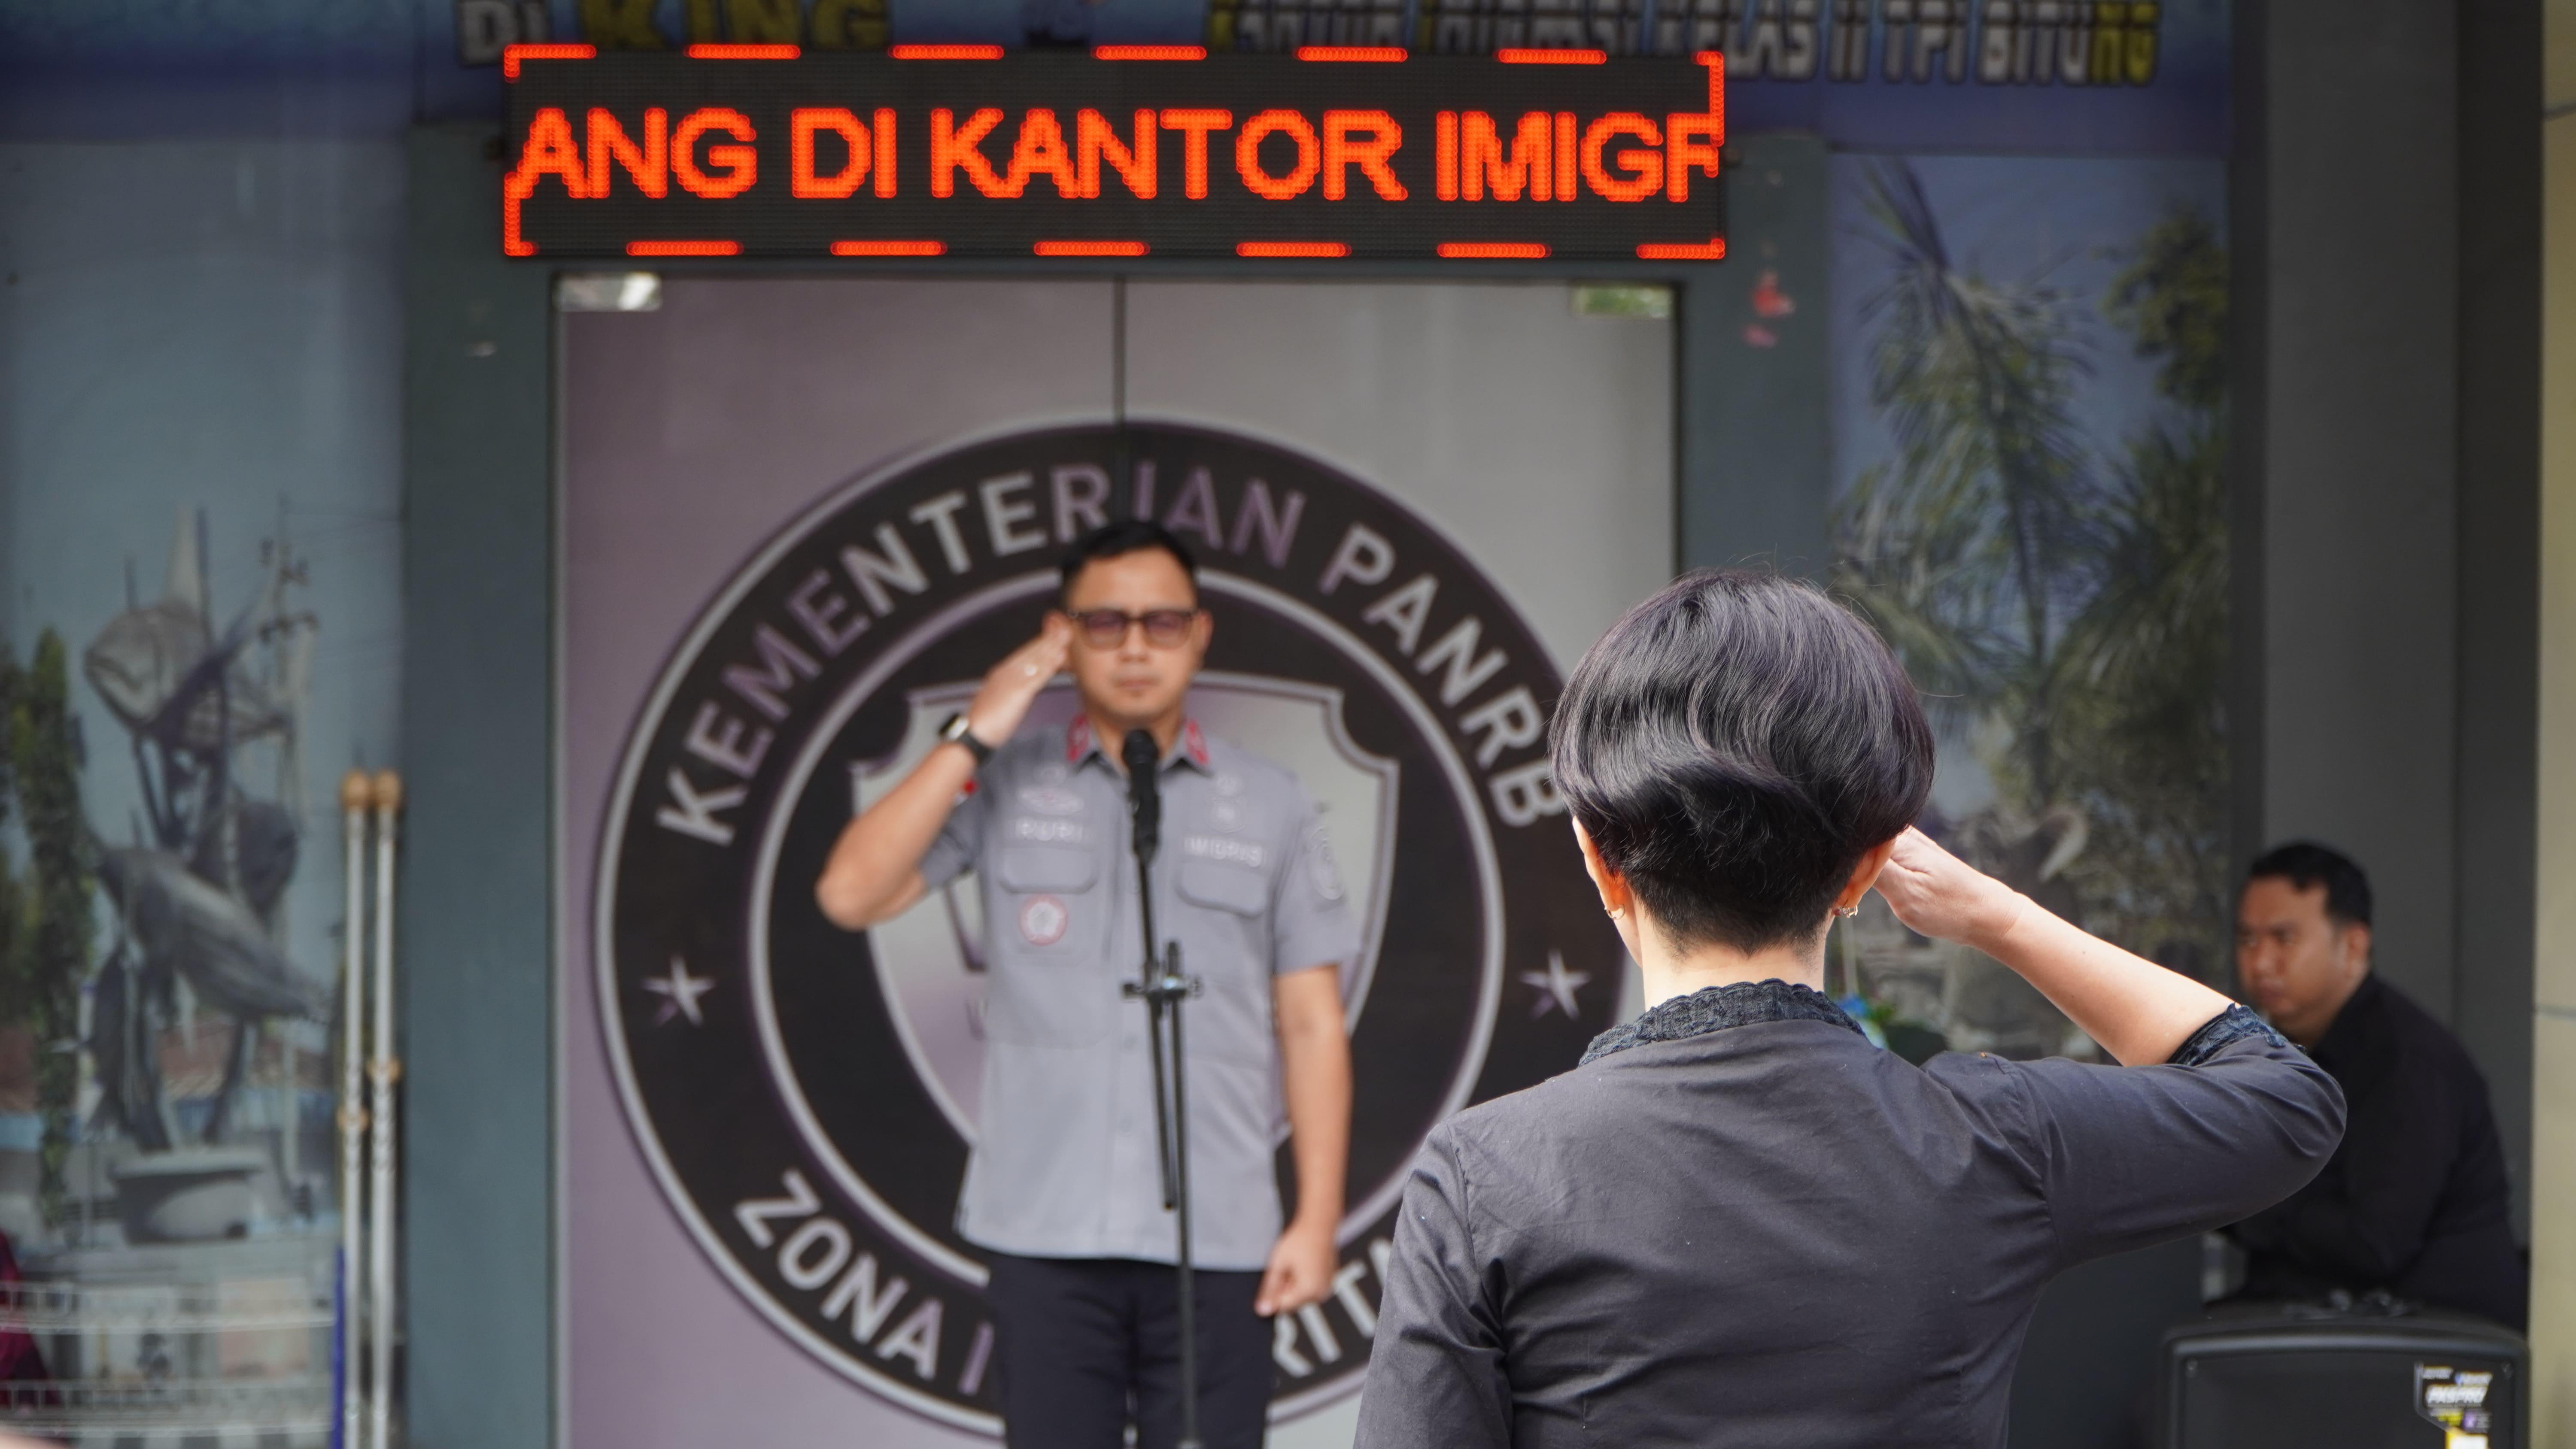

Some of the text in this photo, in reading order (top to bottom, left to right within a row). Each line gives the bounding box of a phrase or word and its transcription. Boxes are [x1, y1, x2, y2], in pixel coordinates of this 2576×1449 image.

[516, 107, 757, 199] ANG
[791, 107, 897, 199] DI
[931, 107, 1409, 201] KANTOR
[656, 460, 1566, 846] KEMENTERIAN PANRB
[733, 1167, 944, 1380] ZONA
